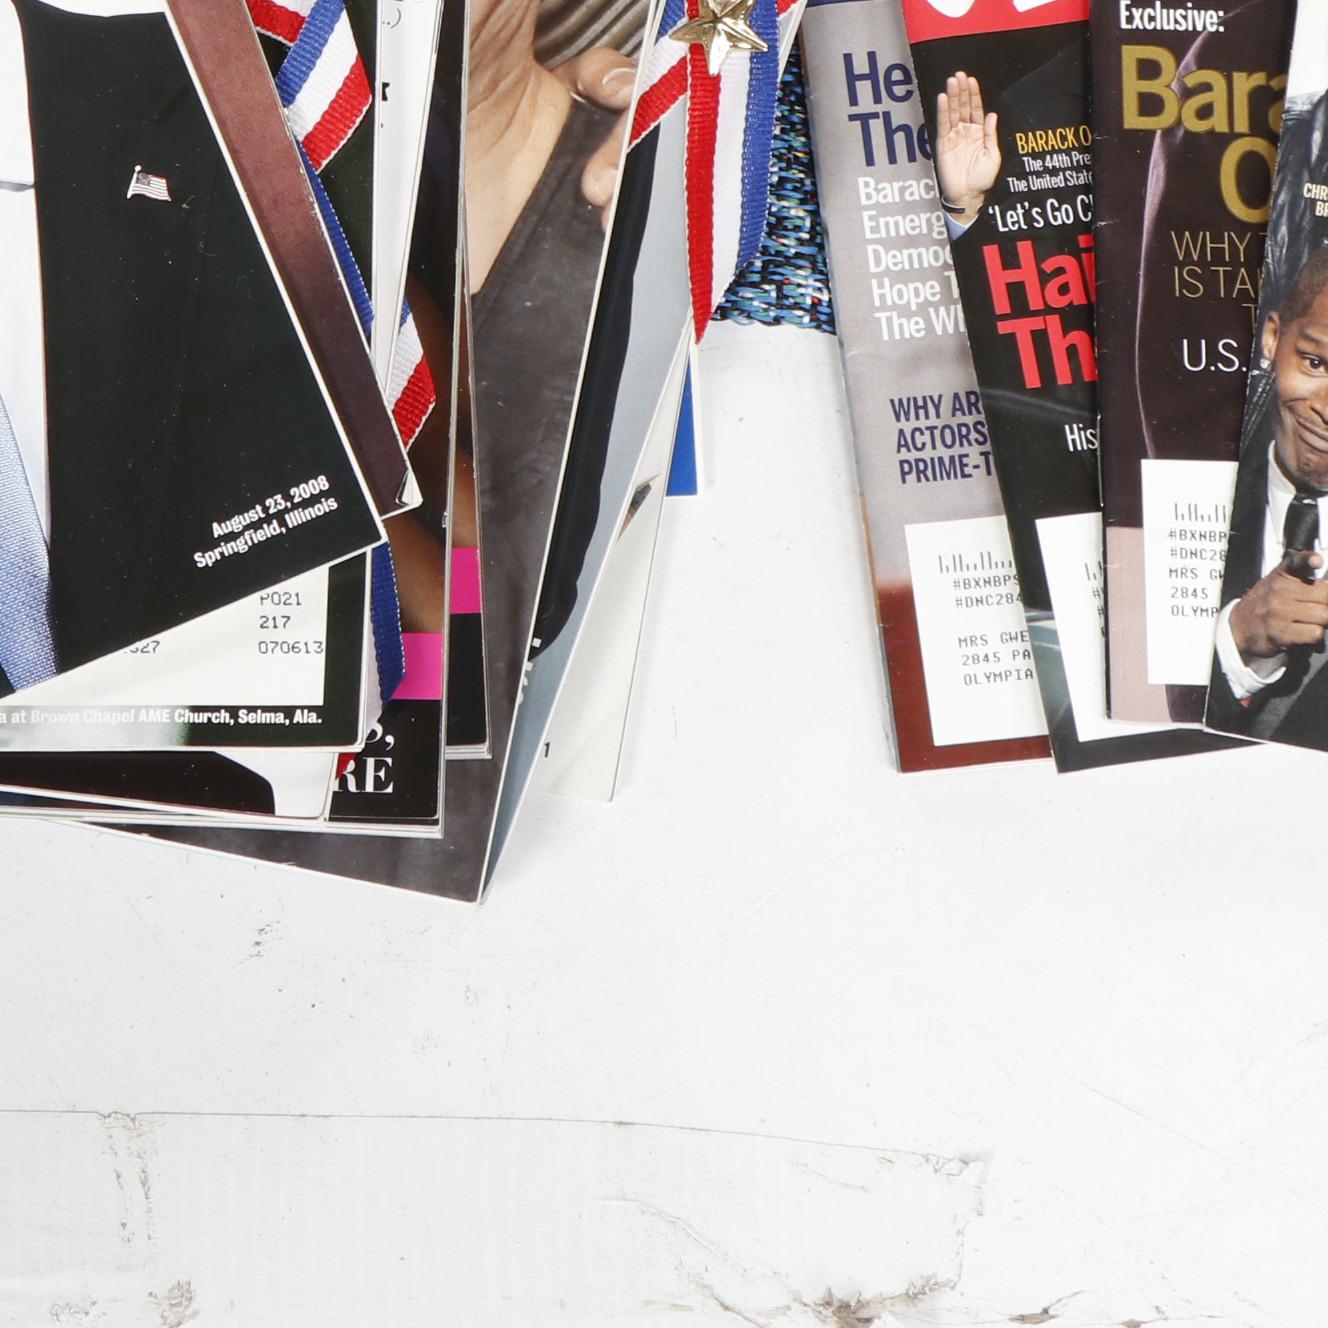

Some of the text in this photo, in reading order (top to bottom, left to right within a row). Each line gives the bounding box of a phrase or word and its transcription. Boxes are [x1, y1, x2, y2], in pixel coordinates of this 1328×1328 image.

[1119, 0, 1225, 32] Exclusive:
[1016, 127, 1078, 154] BARACK
[1022, 153, 1071, 172] The 44th
[1007, 172, 1065, 192] The United
[1046, 198, 1073, 226] Go
[1171, 231, 1250, 262] WHY
[872, 278, 941, 310] Hope
[1174, 266, 1203, 298] IS
[875, 312, 927, 341] The
[1183, 338, 1247, 372] U.S.
[890, 395, 943, 423] WHY
[895, 422, 987, 454] ACTORS
[211, 475, 330, 538] August 23, 2008
[193, 496, 339, 568] Springfield, Illinois
[1169, 567, 1198, 580] MRS
[1171, 586, 1209, 600] 2845
[259, 616, 291, 629] 217
[258, 641, 324, 654] 070613
[958, 635, 988, 649] MRS
[961, 652, 1001, 666] 2845
[964, 669, 1034, 687] OLYMPIA
[11, 708, 323, 727] at Brown Chapel AME Church, Selma, Ala.
